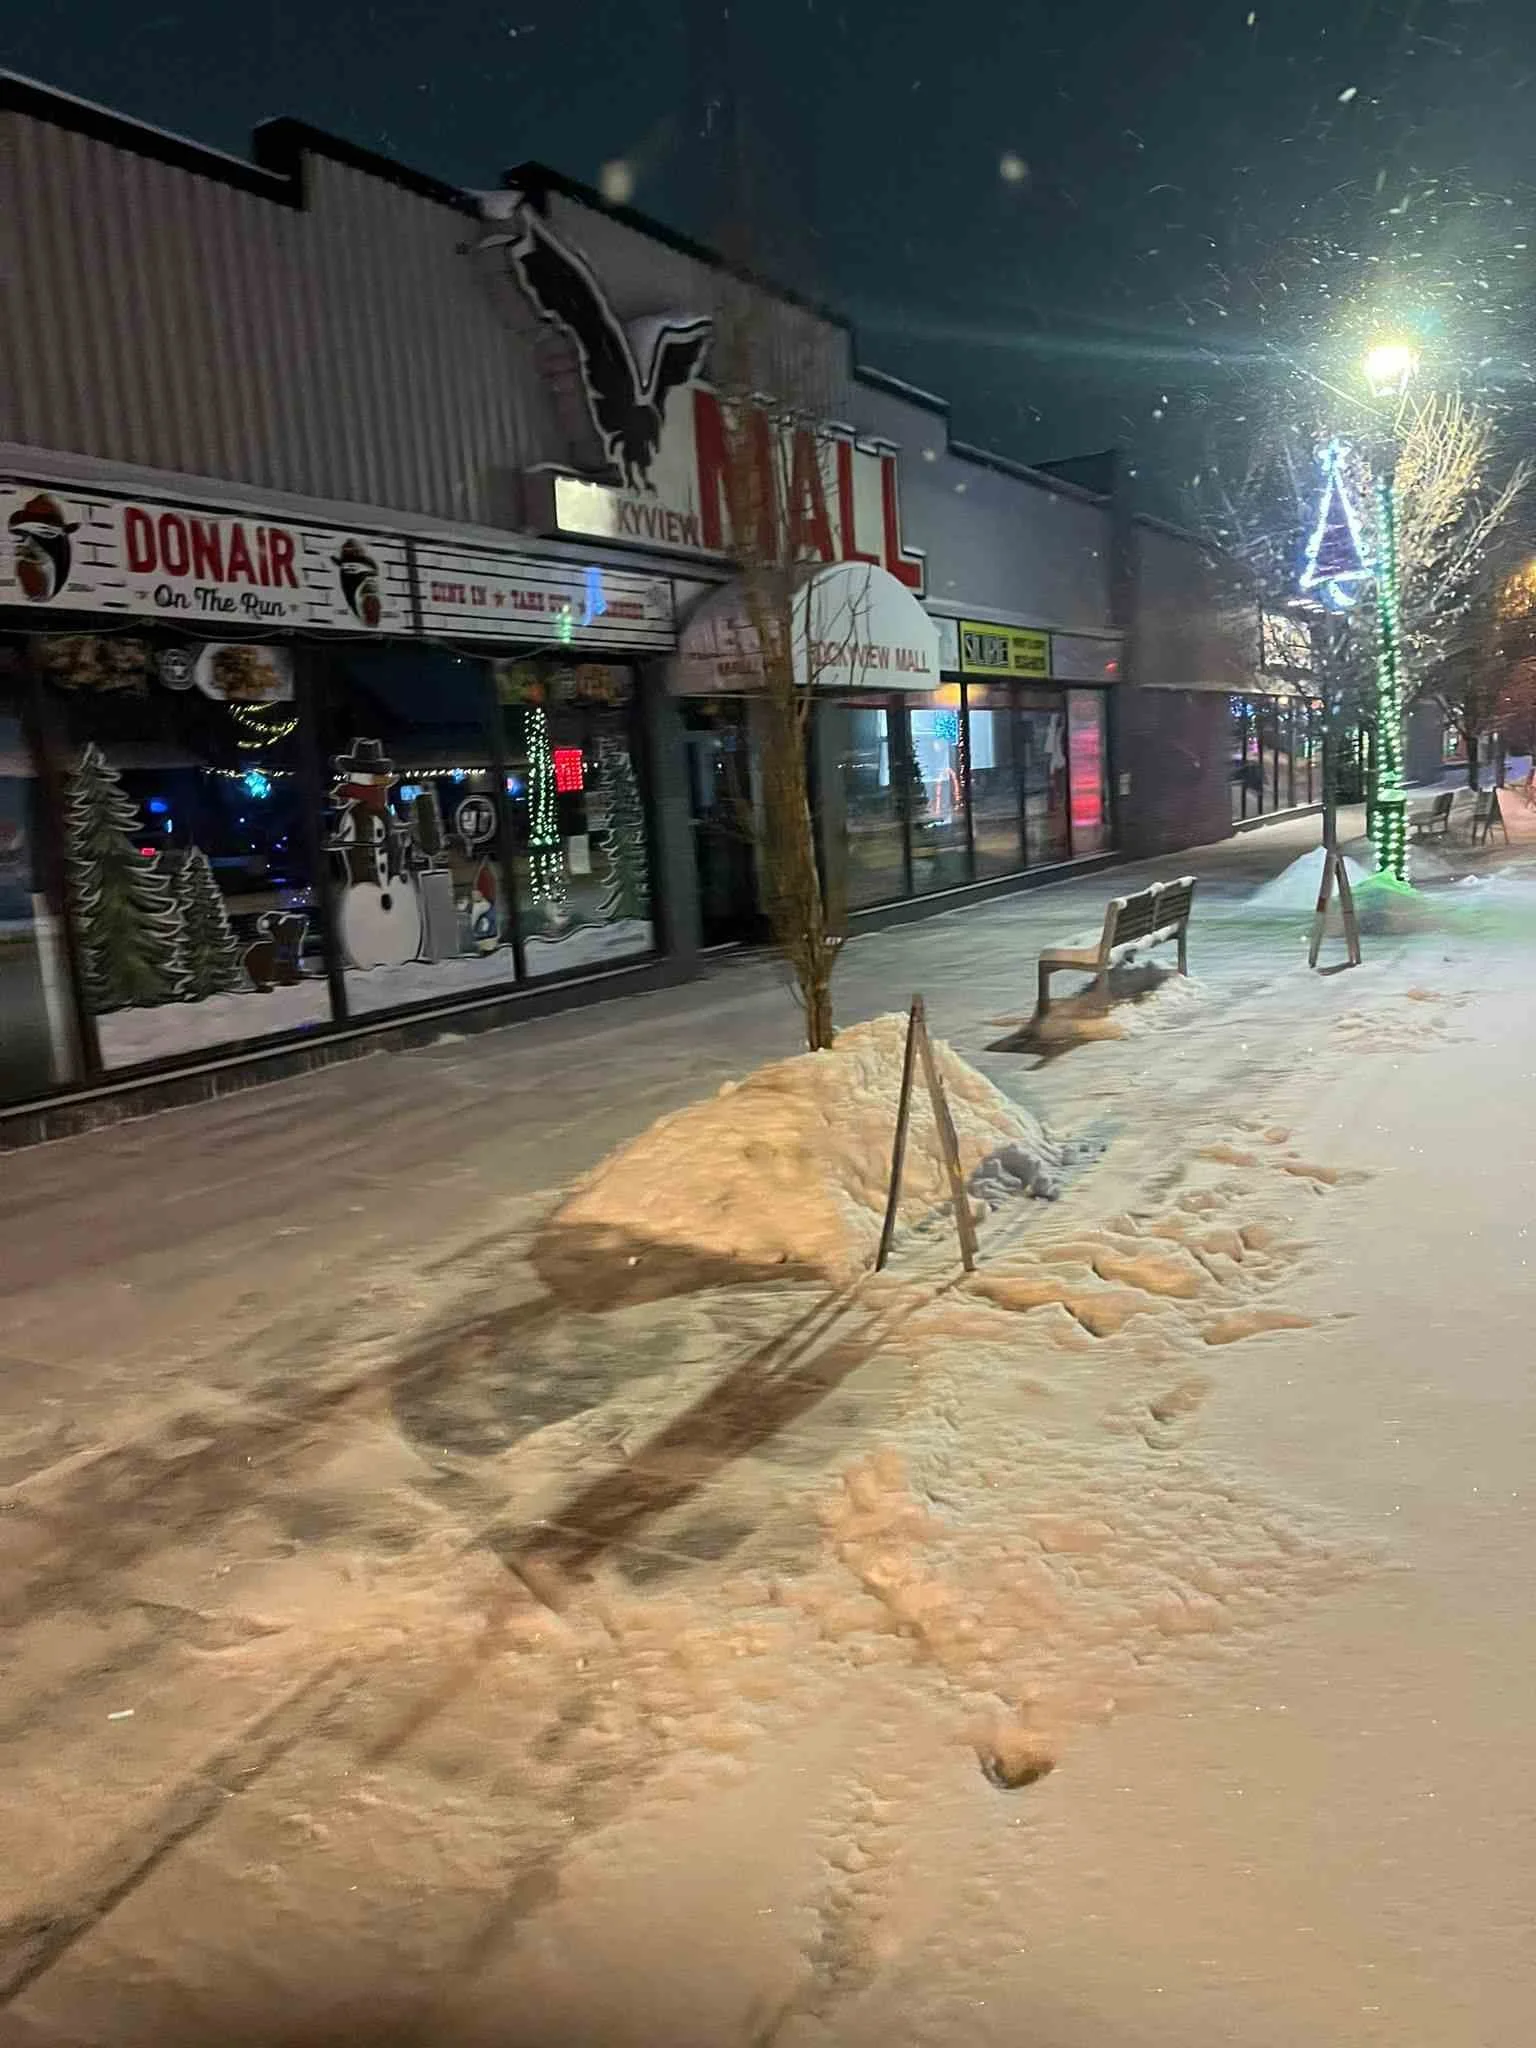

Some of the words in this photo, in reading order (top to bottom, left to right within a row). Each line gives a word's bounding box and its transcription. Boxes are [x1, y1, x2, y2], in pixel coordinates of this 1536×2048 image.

[694, 389, 922, 588] MALL
[616, 497, 701, 548] KYVIEW
[154, 583, 191, 609] On
[194, 586, 238, 613] The
[240, 592, 287, 620] Run
[895, 646, 931, 673] MALL
